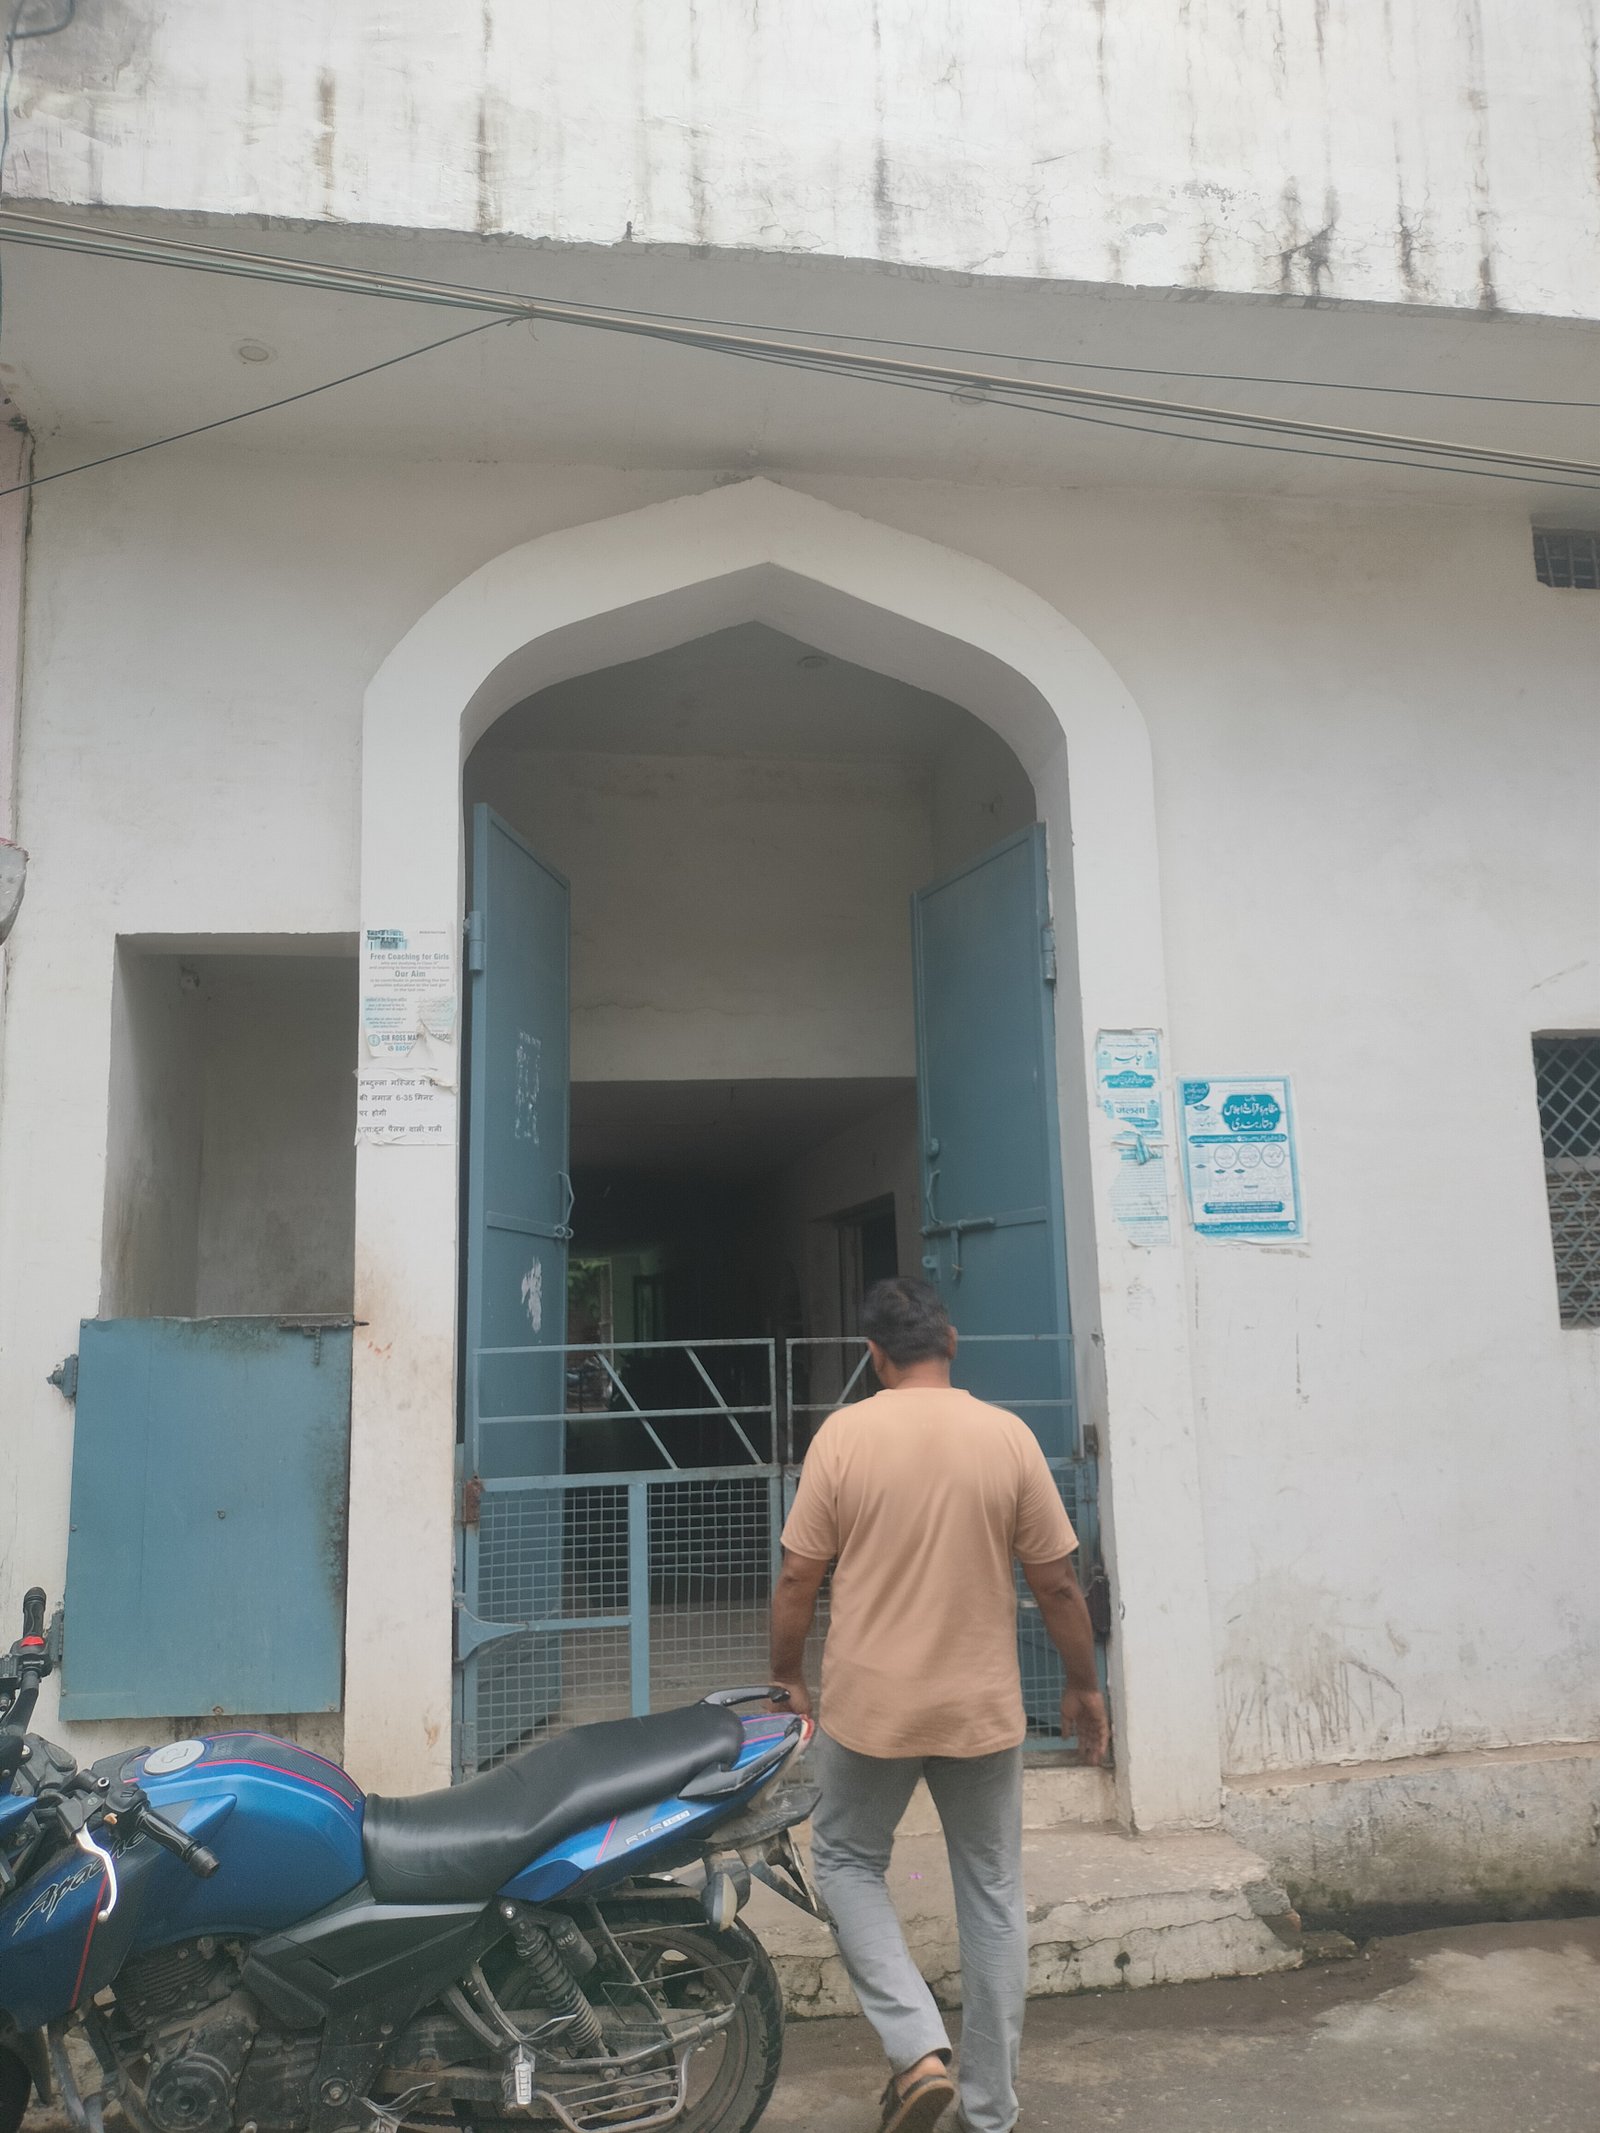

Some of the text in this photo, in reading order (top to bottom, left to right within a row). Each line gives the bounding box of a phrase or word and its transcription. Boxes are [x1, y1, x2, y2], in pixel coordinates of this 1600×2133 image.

[388, 953, 421, 961] Coaching
[395, 970, 426, 978] Our Aim
[625, 1823, 663, 1846] RTR
